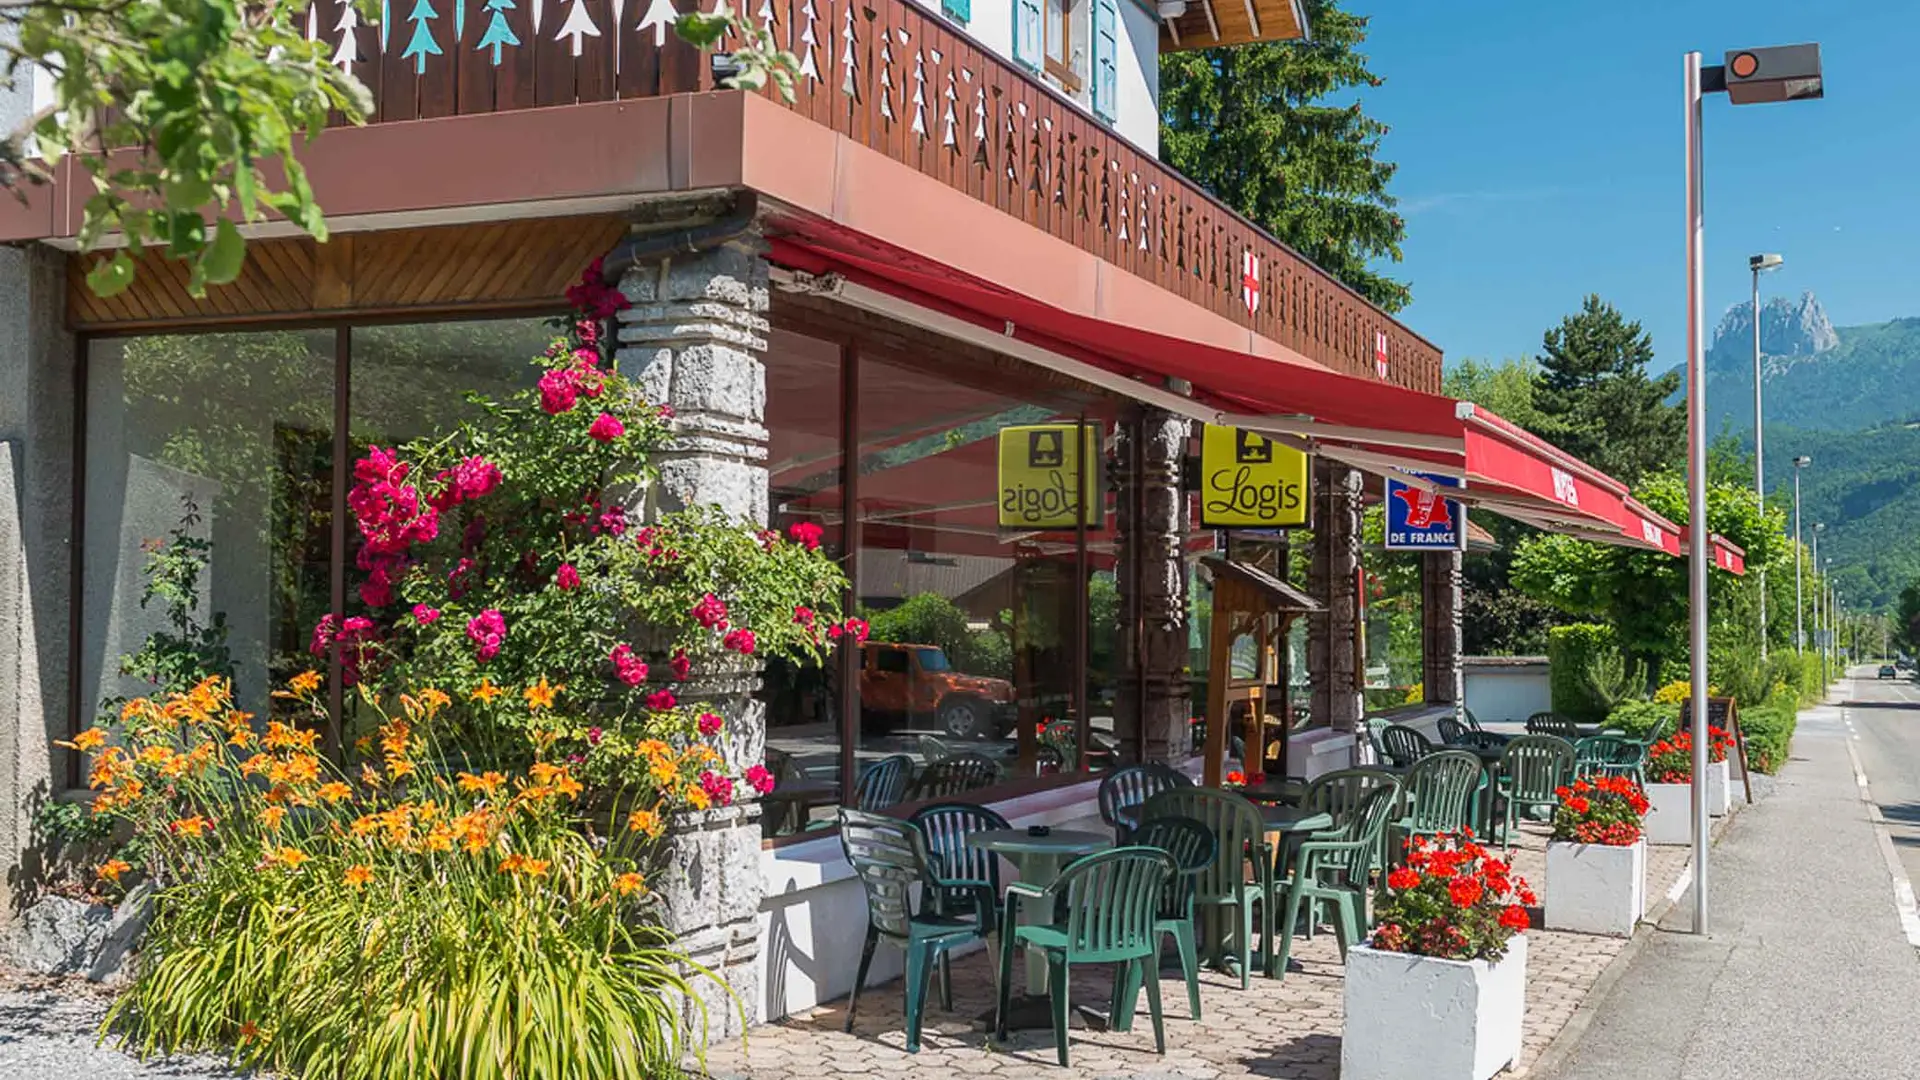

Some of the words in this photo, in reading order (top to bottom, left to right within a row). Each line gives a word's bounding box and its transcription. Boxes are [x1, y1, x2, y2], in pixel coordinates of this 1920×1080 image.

[1207, 465, 1301, 520] Logis
[1390, 532, 1406, 544] DE
[1410, 532, 1456, 544] FRANCE
